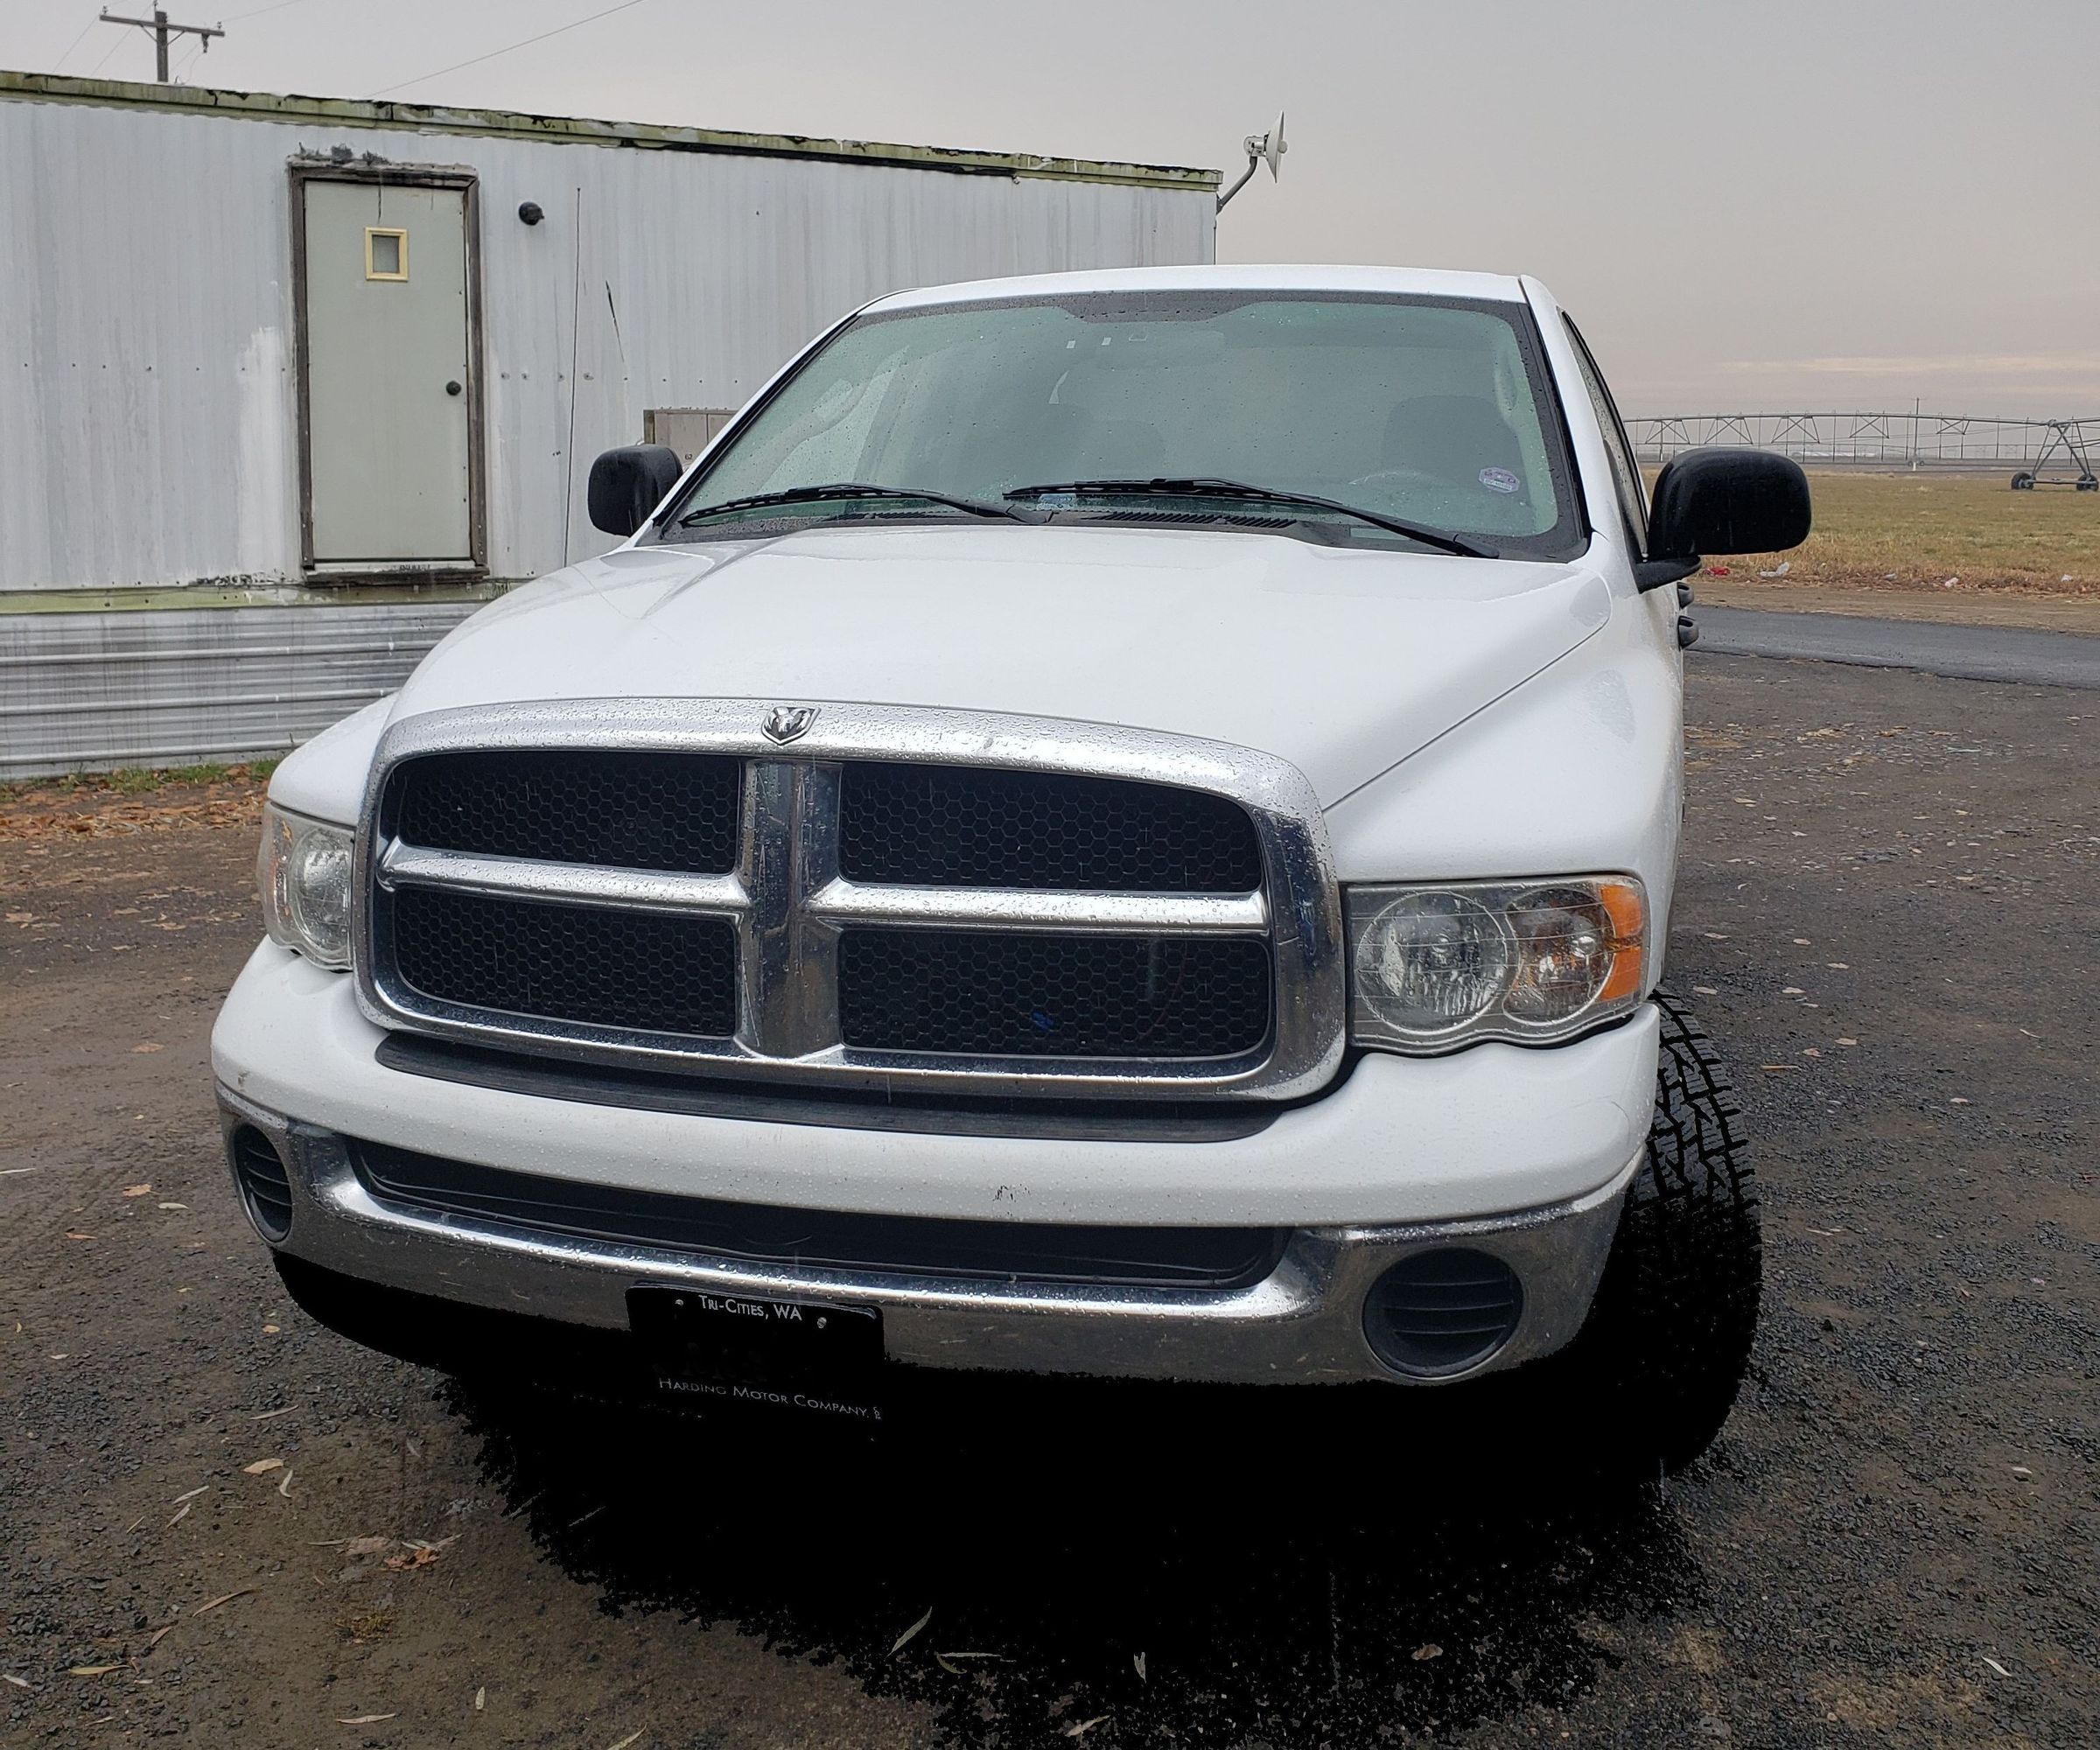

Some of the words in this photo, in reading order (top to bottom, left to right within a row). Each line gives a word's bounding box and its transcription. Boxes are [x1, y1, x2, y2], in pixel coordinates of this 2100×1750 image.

[774, 1304, 802, 1320] WA
[659, 1377, 727, 1395] HARDING
[733, 1385, 788, 1404] MOTOR
